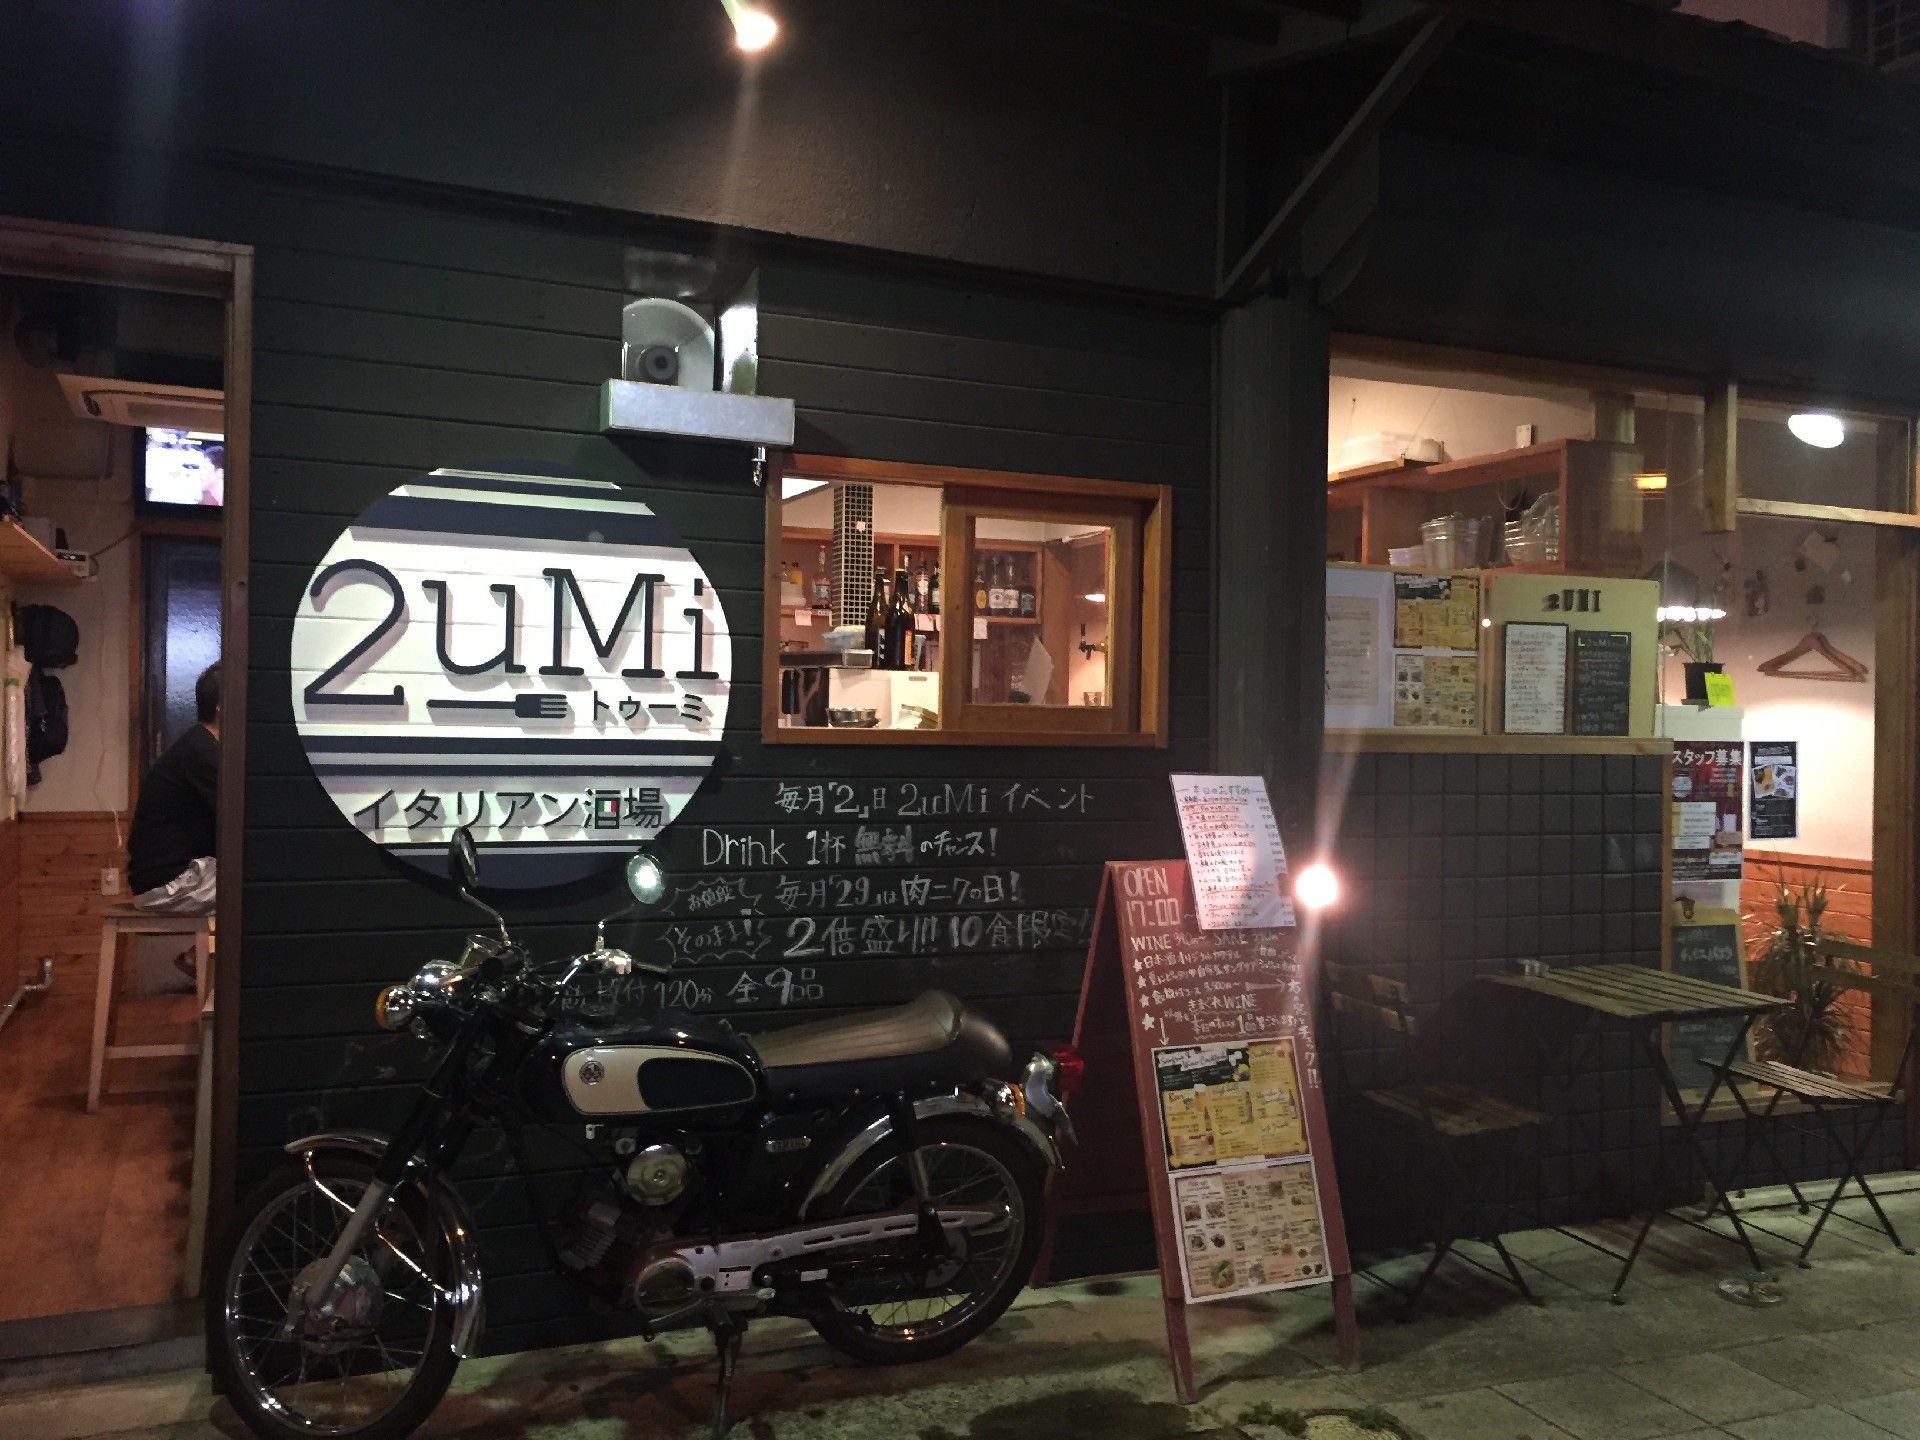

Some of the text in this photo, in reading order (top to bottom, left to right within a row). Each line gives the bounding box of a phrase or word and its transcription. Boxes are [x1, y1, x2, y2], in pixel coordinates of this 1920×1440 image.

[304, 559, 719, 705] 2uMi
[593, 690, 704, 723] トゥーミ
[1672, 748, 1742, 766] スタッフ募集
[354, 787, 664, 830] イタリアン酒場
[703, 827, 789, 868] Drink
[1124, 867, 1169, 898] OPEN
[1131, 934, 1172, 951] WINE
